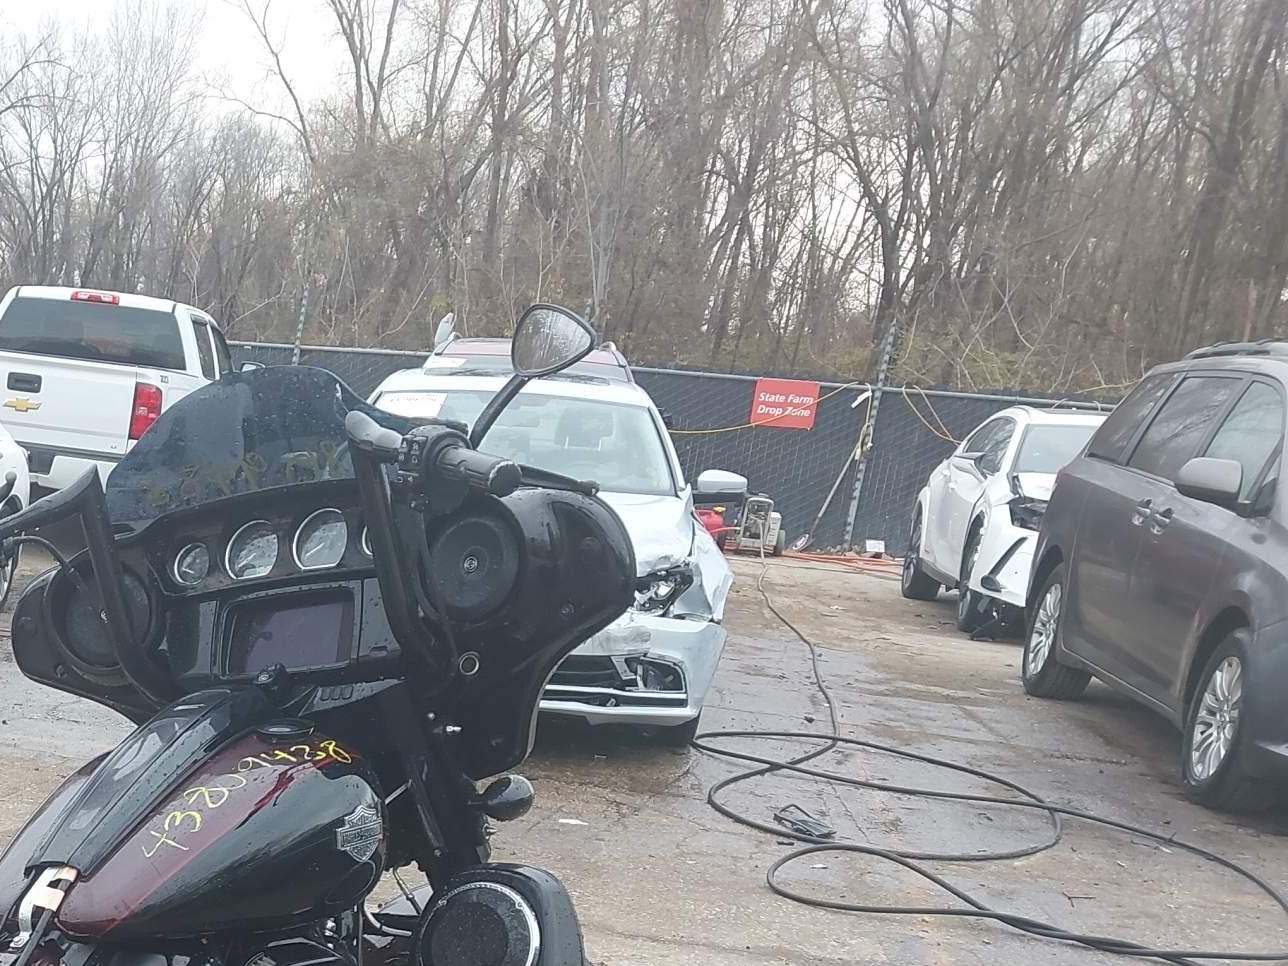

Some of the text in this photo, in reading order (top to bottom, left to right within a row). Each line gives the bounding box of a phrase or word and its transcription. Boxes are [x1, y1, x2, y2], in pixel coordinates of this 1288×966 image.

[759, 392, 814, 405] State Farm
[757, 404, 811, 417] Drop Zone
